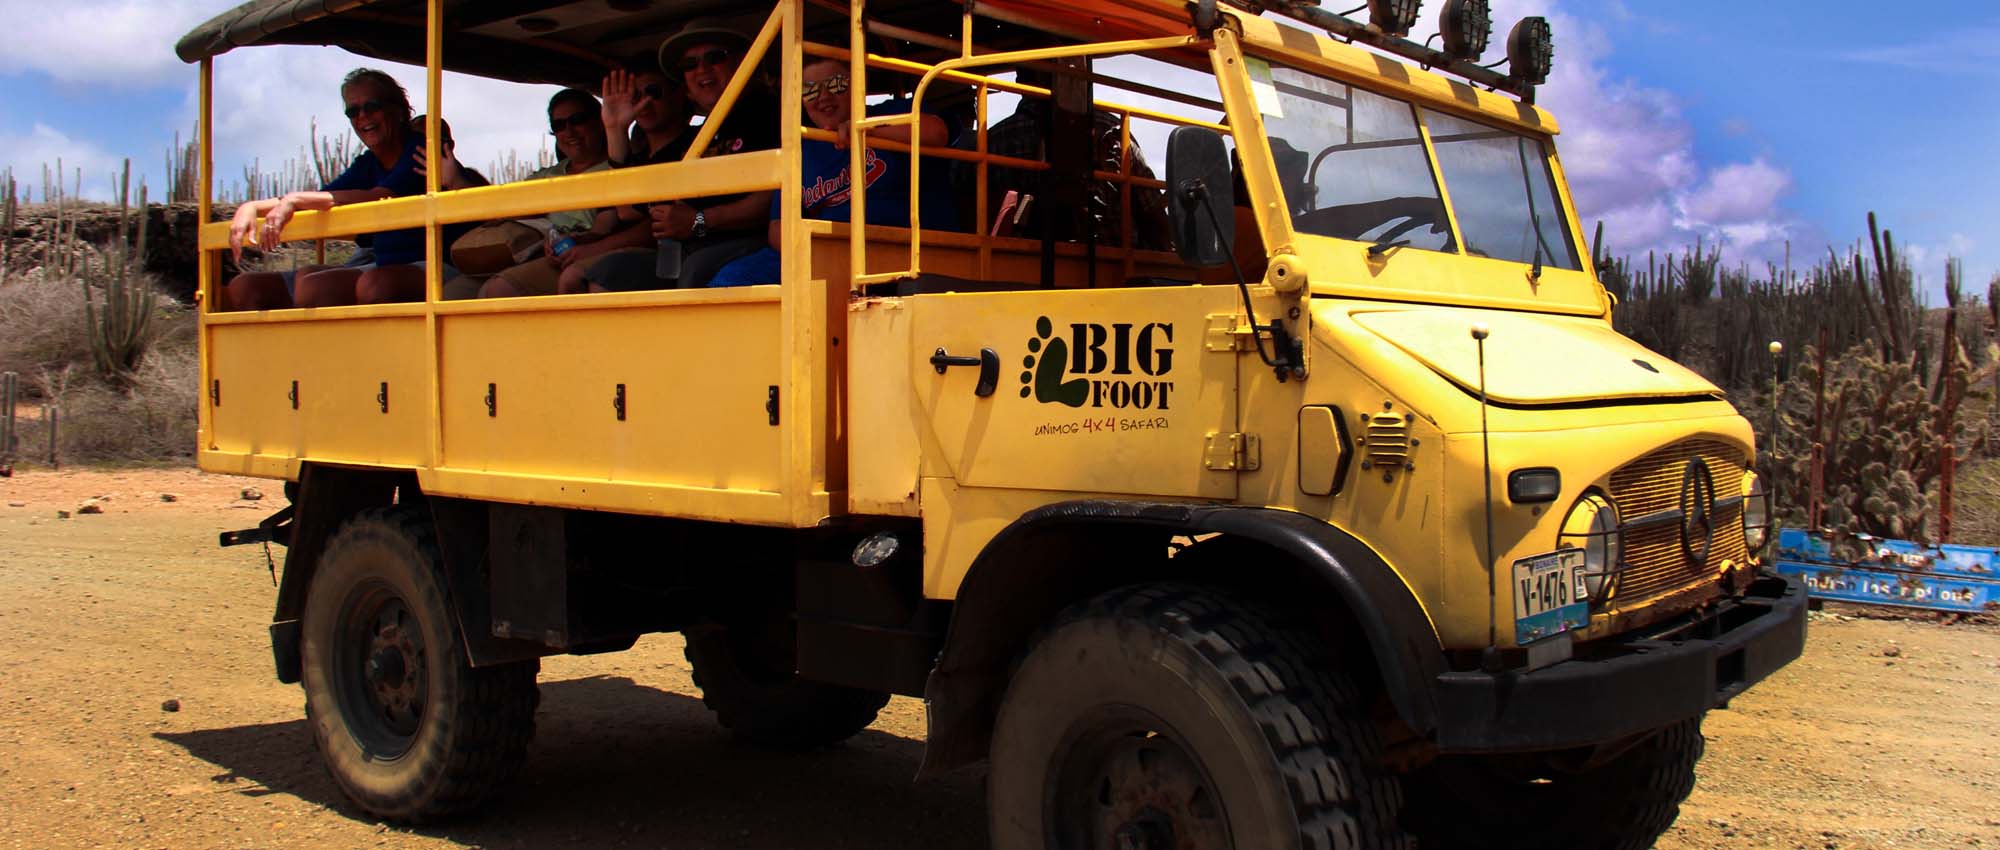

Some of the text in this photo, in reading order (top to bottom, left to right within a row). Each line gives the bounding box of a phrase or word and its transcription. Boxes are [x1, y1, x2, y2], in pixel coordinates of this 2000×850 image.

[1069, 322, 1174, 376] BIG
[1091, 380, 1174, 409] FOOT
[1034, 422, 1079, 436] UNIMOG
[1119, 417, 1169, 431] SAFARI
[1520, 569, 1567, 616] V-1476
[1862, 579, 1976, 601] Inscrptions
